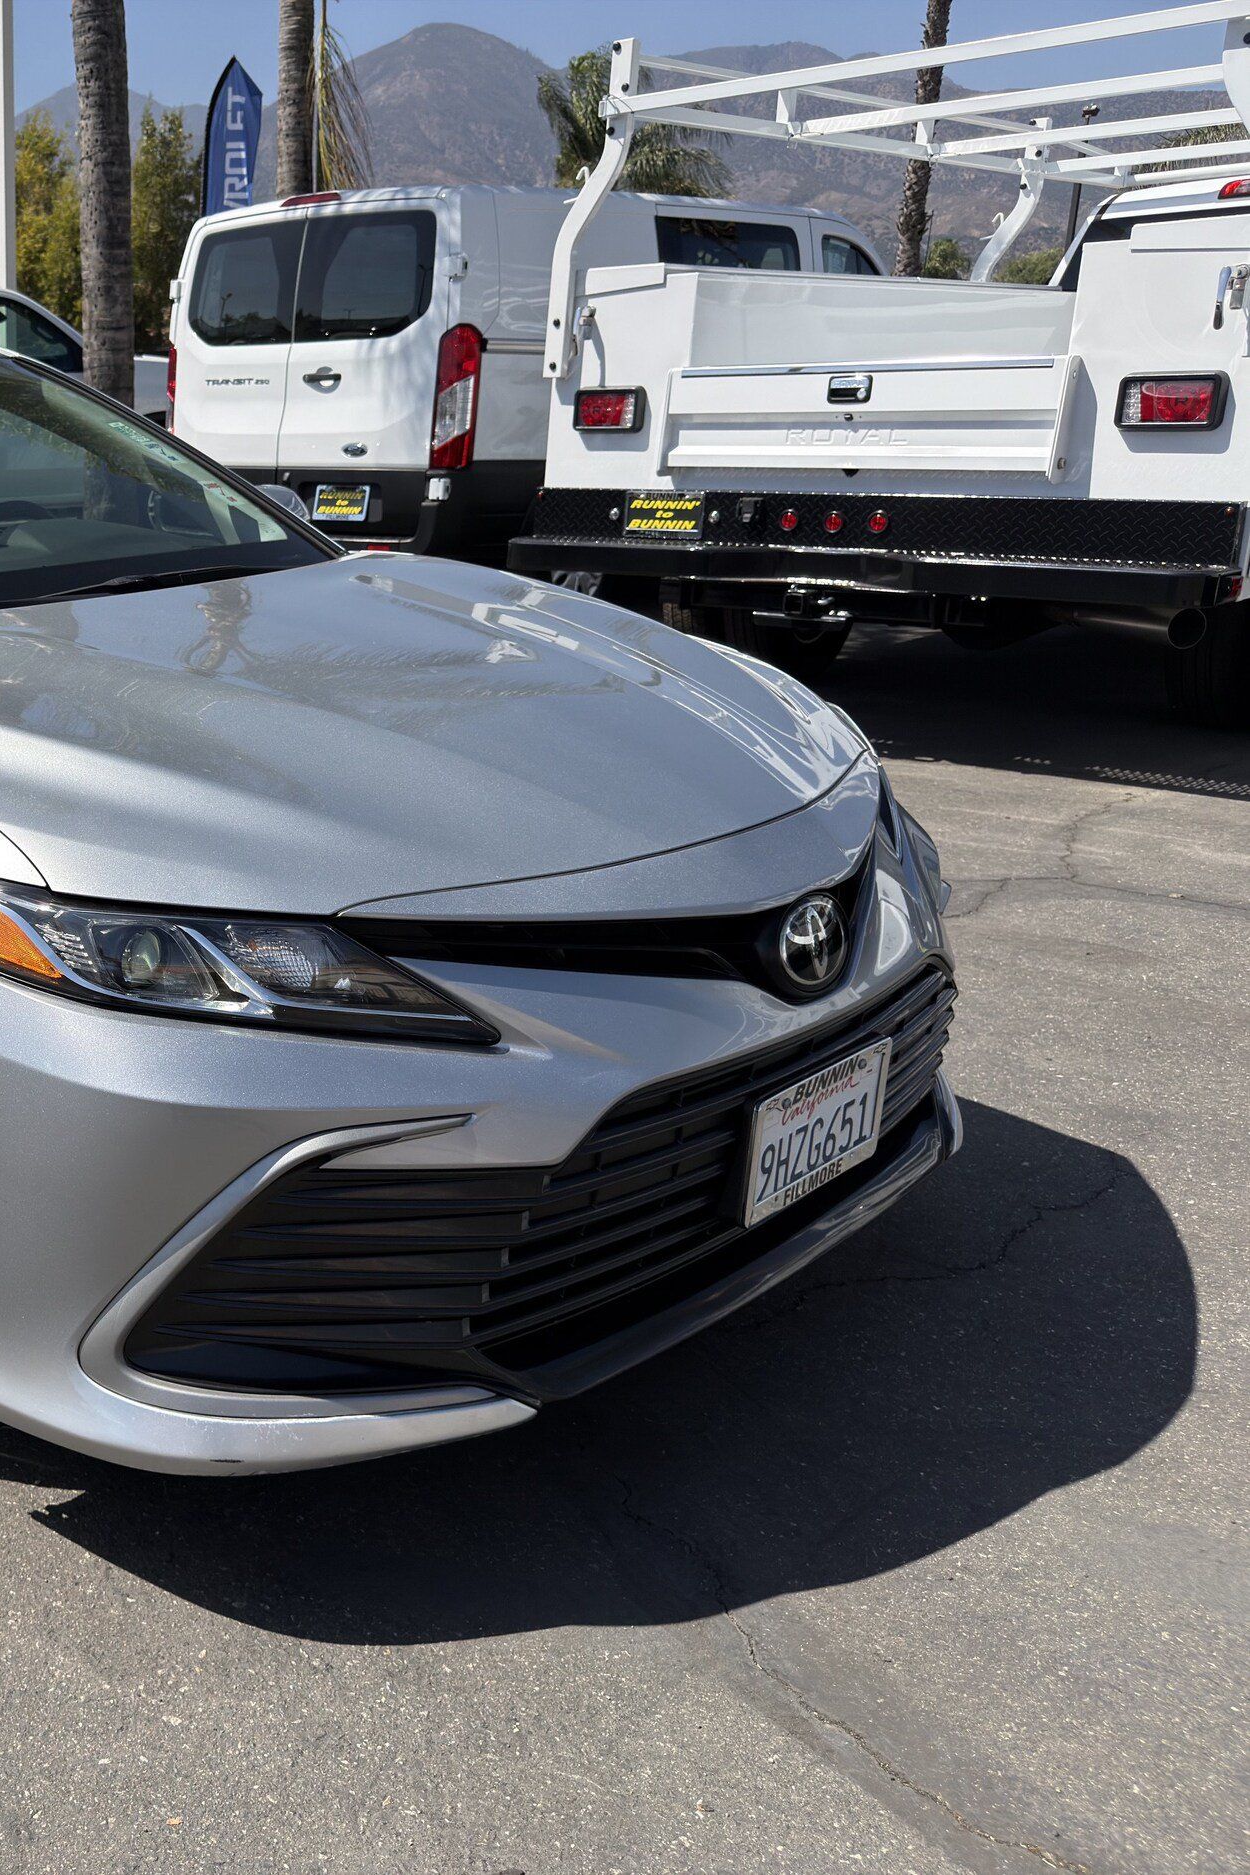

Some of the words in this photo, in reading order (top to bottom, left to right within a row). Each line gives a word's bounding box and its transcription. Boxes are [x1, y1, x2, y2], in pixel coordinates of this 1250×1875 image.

[205, 378, 254, 386] TRANSIT
[784, 429, 910, 446] ROYAL
[316, 505, 362, 515] BUNNIN
[630, 499, 701, 510] RUNNIN'
[655, 510, 674, 518] to
[628, 519, 696, 530] BUNNIN
[791, 1055, 860, 1106] BUNNIN
[781, 1075, 859, 1126] California
[755, 1092, 869, 1203] 9HZG651
[783, 1157, 843, 1207] FILLMORE
